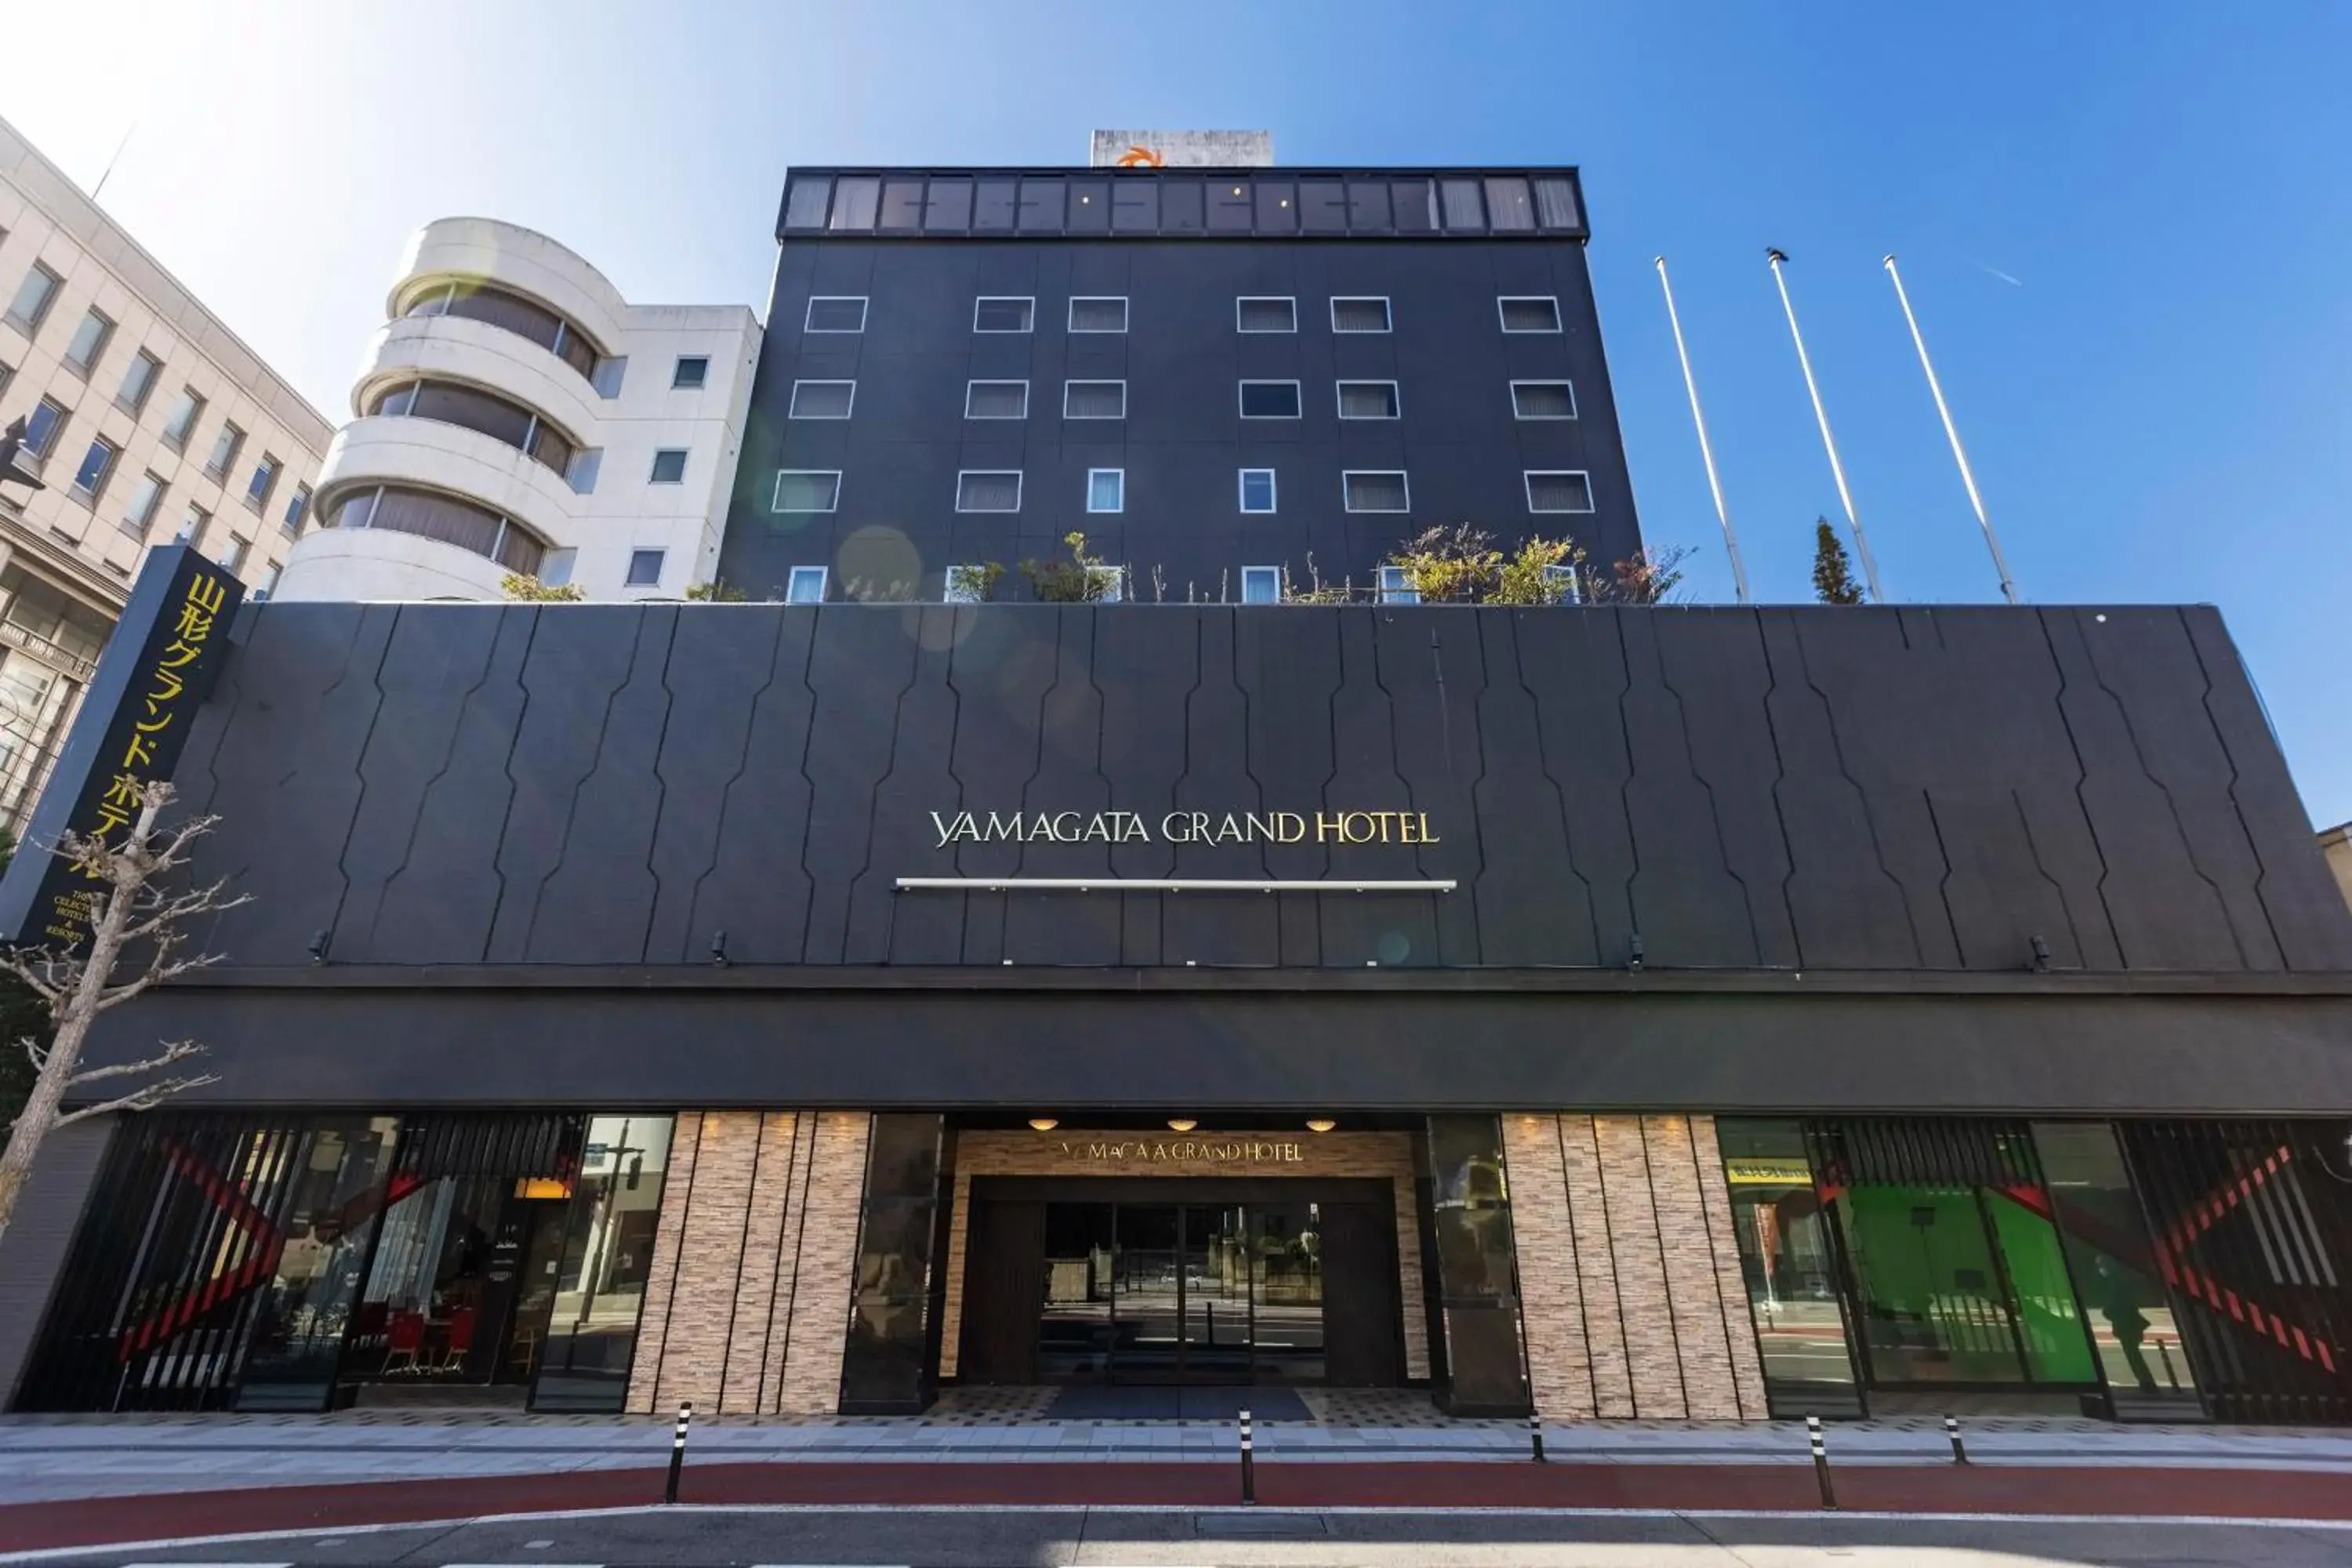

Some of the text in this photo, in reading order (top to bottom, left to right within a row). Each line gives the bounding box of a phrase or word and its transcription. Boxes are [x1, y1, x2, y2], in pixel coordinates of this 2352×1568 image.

[68, 572, 226, 879] 山形グランドホテ
[929, 811, 1440, 848] YAMAGATA GRAND HOTEL
[1171, 1142, 1241, 1160] GRAND
[1245, 1142, 1305, 1161] HOTEL
